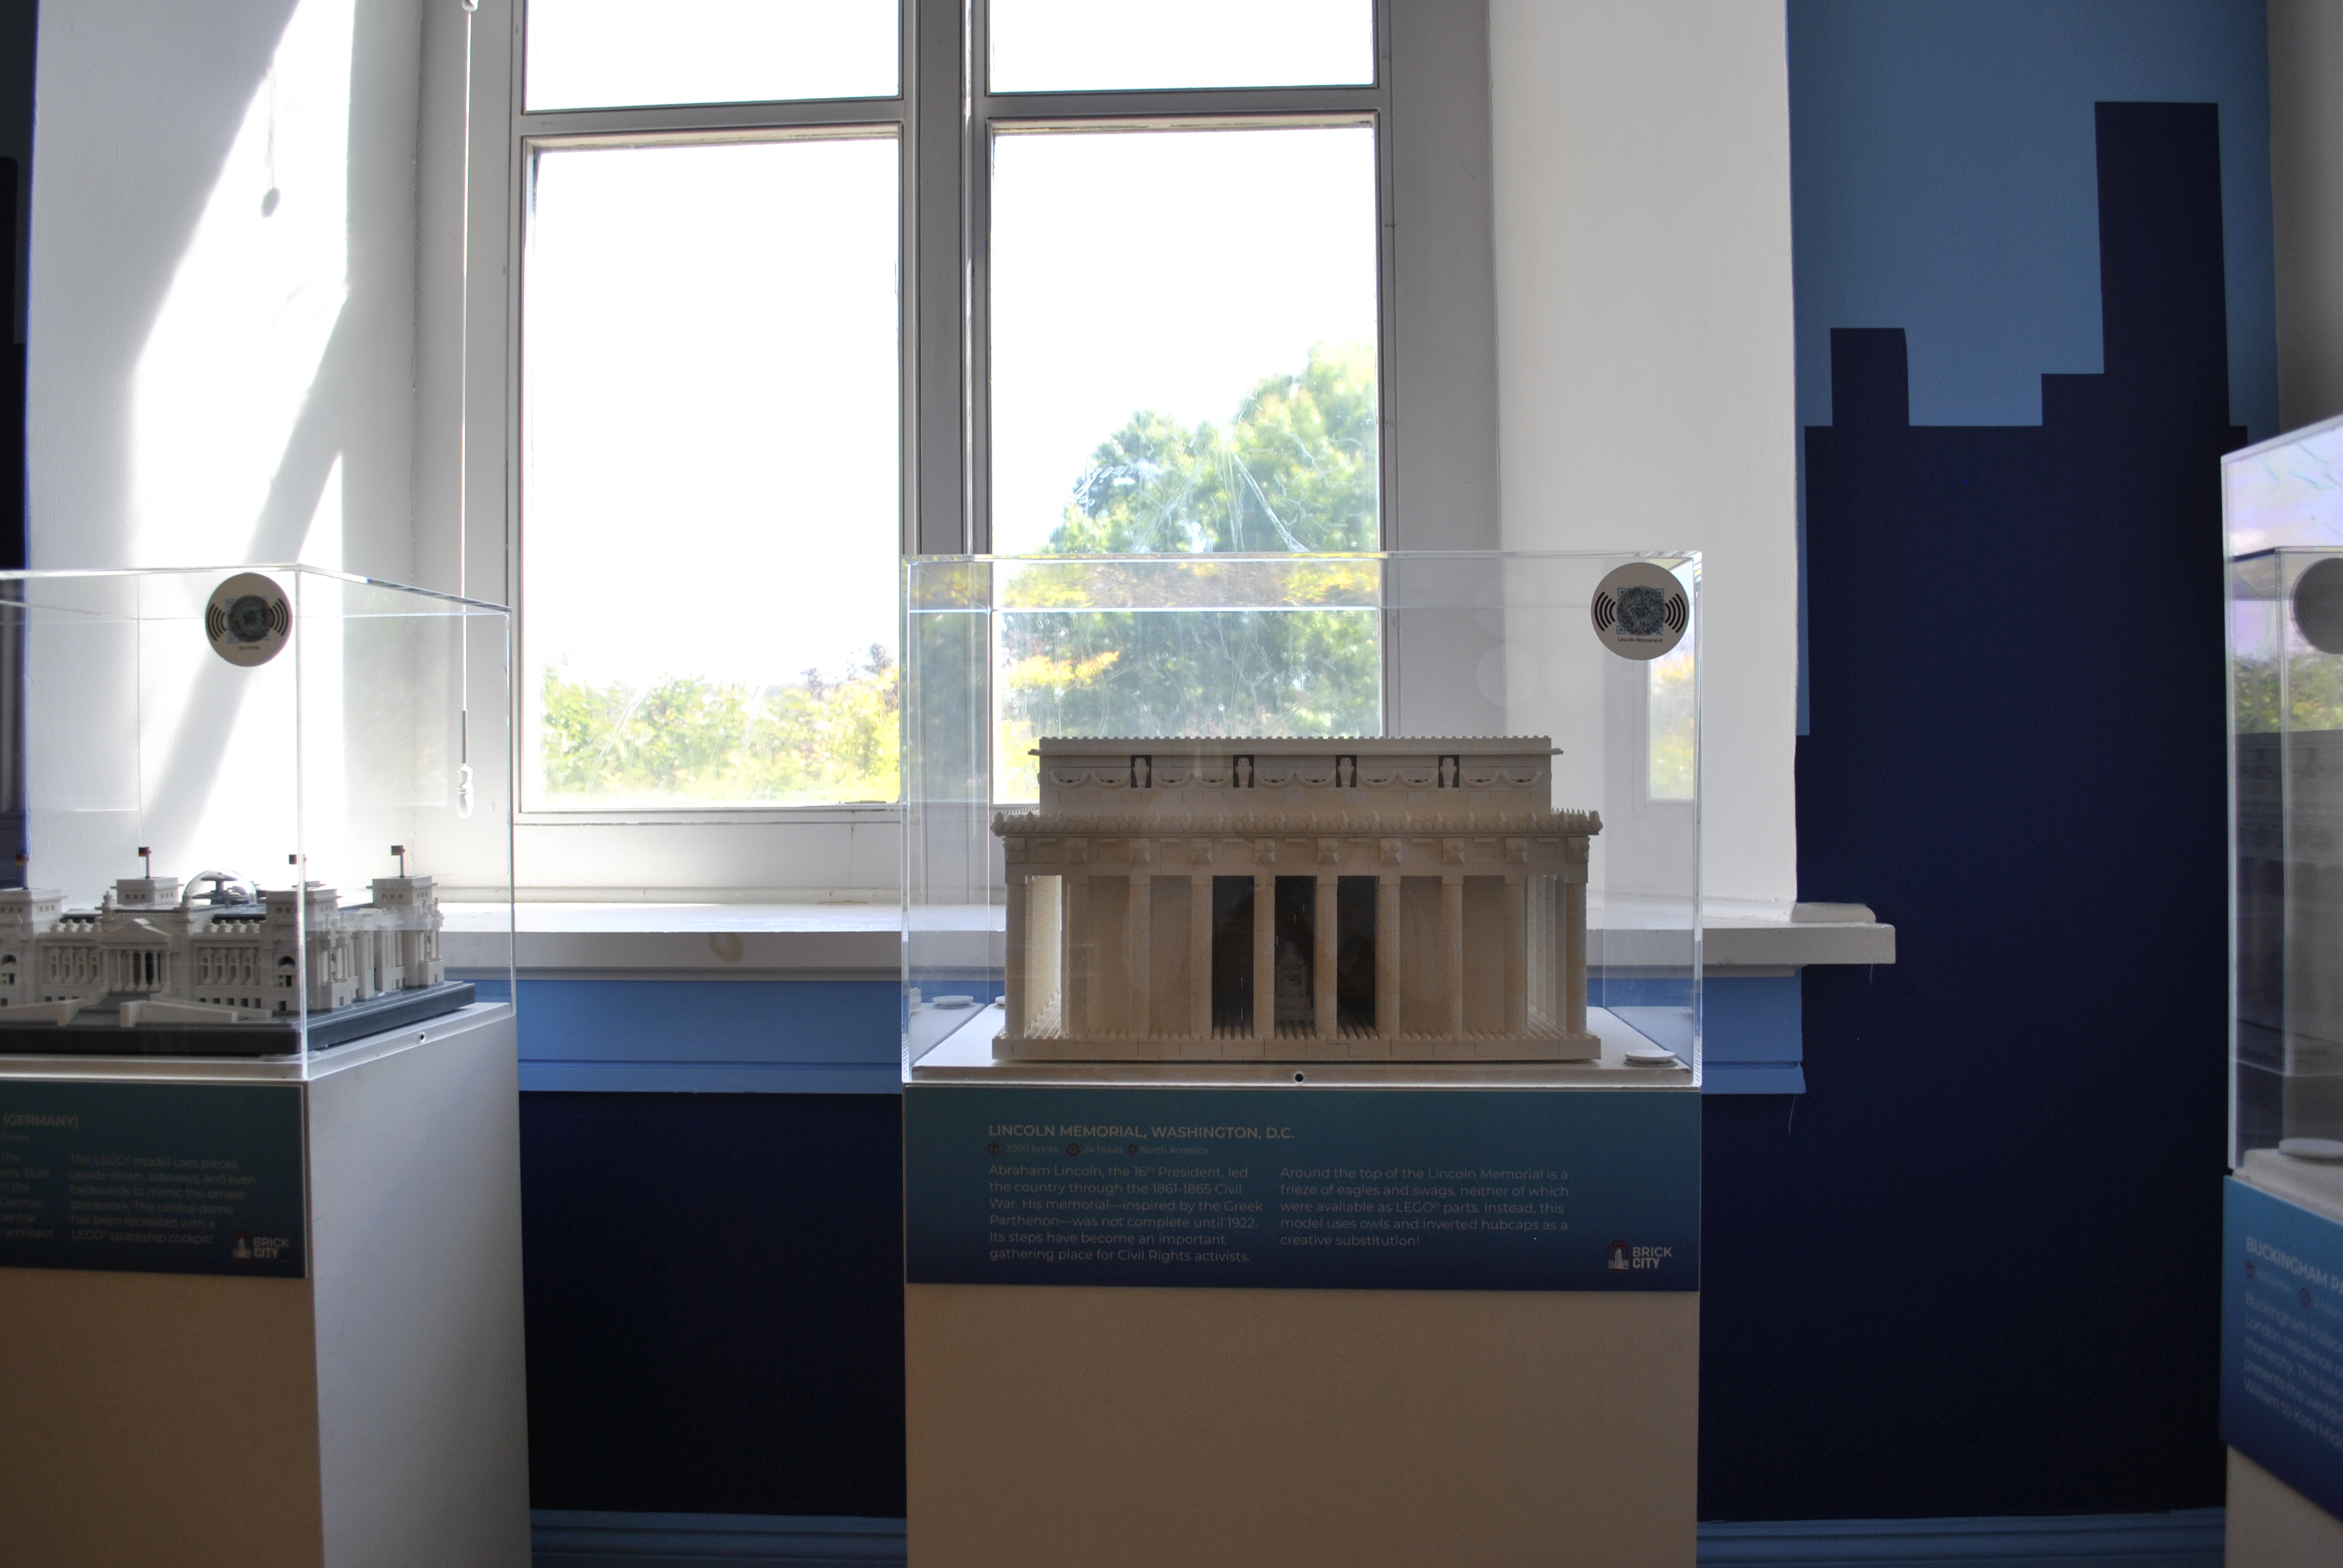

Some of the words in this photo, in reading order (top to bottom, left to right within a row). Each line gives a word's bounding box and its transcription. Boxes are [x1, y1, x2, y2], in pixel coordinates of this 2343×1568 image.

[4, 1113, 79, 1129] (GERMANY)
[989, 1125, 1055, 1136] LINCOLN
[1060, 1126, 1147, 1140] MEMORIAL,
[1151, 1126, 1261, 1140] WASHINGTON,
[1267, 1128, 1294, 1138] D.C.
[1006, 1145, 1029, 1153] 2000
[1032, 1145, 1059, 1153] bricks
[1097, 1145, 1124, 1154] hours
[989, 1165, 1049, 1175] Abraham
[1054, 1166, 1104, 1178] Lincoln,
[1109, 1166, 1130, 1177] the
[1159, 1166, 1224, 1178] President,
[1228, 1167, 1248, 1178] led
[1280, 1167, 1330, 1178] Around
[1334, 1168, 1356, 1178] the
[1360, 1169, 1381, 1181] top
[1386, 1168, 1399, 1178] of
[1402, 1168, 1424, 1178] the
[1428, 1169, 1476, 1179] Lincoln
[1480, 1169, 1542, 1180] Memorial
[1547, 1169, 1557, 1180] is
[989, 1181, 1011, 1192] the
[1015, 1183, 1065, 1195] country
[1069, 1183, 1122, 1195] through
[1127, 1184, 1148, 1194] the
[1152, 1183, 1211, 1194] 1861-1865
[1215, 1183, 1242, 1194] Civil
[1281, 1184, 1317, 1195] frieze
[1320, 1184, 1334, 1195] of
[1337, 1184, 1380, 1198] eagles
[1383, 1185, 1409, 1195] and
[1413, 1186, 1457, 1198] swags,
[1460, 1186, 1509, 1197] neither
[1512, 1186, 1527, 1197] of
[1529, 1186, 1568, 1197] which
[989, 1198, 1018, 1209] War.
[1023, 1198, 1042, 1209] His
[1180, 1200, 1194, 1214] by
[1199, 1200, 1220, 1211] the
[1224, 1201, 1263, 1211] Greek
[1280, 1203, 1312, 1212] were
[1317, 1201, 1374, 1212] available
[1378, 1203, 1392, 1212] as
[1444, 1203, 1480, 1214] parts.
[1484, 1203, 1536, 1215] Instead,
[1540, 1203, 1564, 1214] this
[1102, 1218, 1124, 1226] not
[1127, 1218, 1190, 1229] complete
[1194, 1217, 1223, 1227] until
[1227, 1218, 1257, 1228] 1922.
[1281, 1217, 1322, 1228] model
[1327, 1220, 1356, 1229] uses
[1360, 1218, 1389, 1229] owls
[1394, 1218, 1418, 1229] and
[1423, 1220, 1477, 1230] inverted
[1482, 1220, 1539, 1232] hubcaps
[1542, 1222, 1556, 1230] as
[253, 1236, 290, 1248] BRICK
[990, 1232, 1005, 1242] Its
[1009, 1233, 1043, 1244] steps
[1047, 1232, 1077, 1243] have
[1081, 1232, 1135, 1244] become
[1159, 1233, 1225, 1246] important
[1280, 1235, 1332, 1245] creative
[1336, 1235, 1419, 1246] substitution!
[254, 1248, 279, 1259] CITY
[989, 1248, 1054, 1262] gathering
[1058, 1249, 1093, 1261] place
[1097, 1249, 1114, 1259] for
[1118, 1249, 1144, 1260] Civil
[1149, 1250, 1191, 1263] Rights
[1194, 1250, 1250, 1262] activists.
[1632, 1247, 1673, 1257] BRICK
[1632, 1258, 1660, 1269] CITY
[2246, 1235, 2327, 1288] BUCKINGHAM
